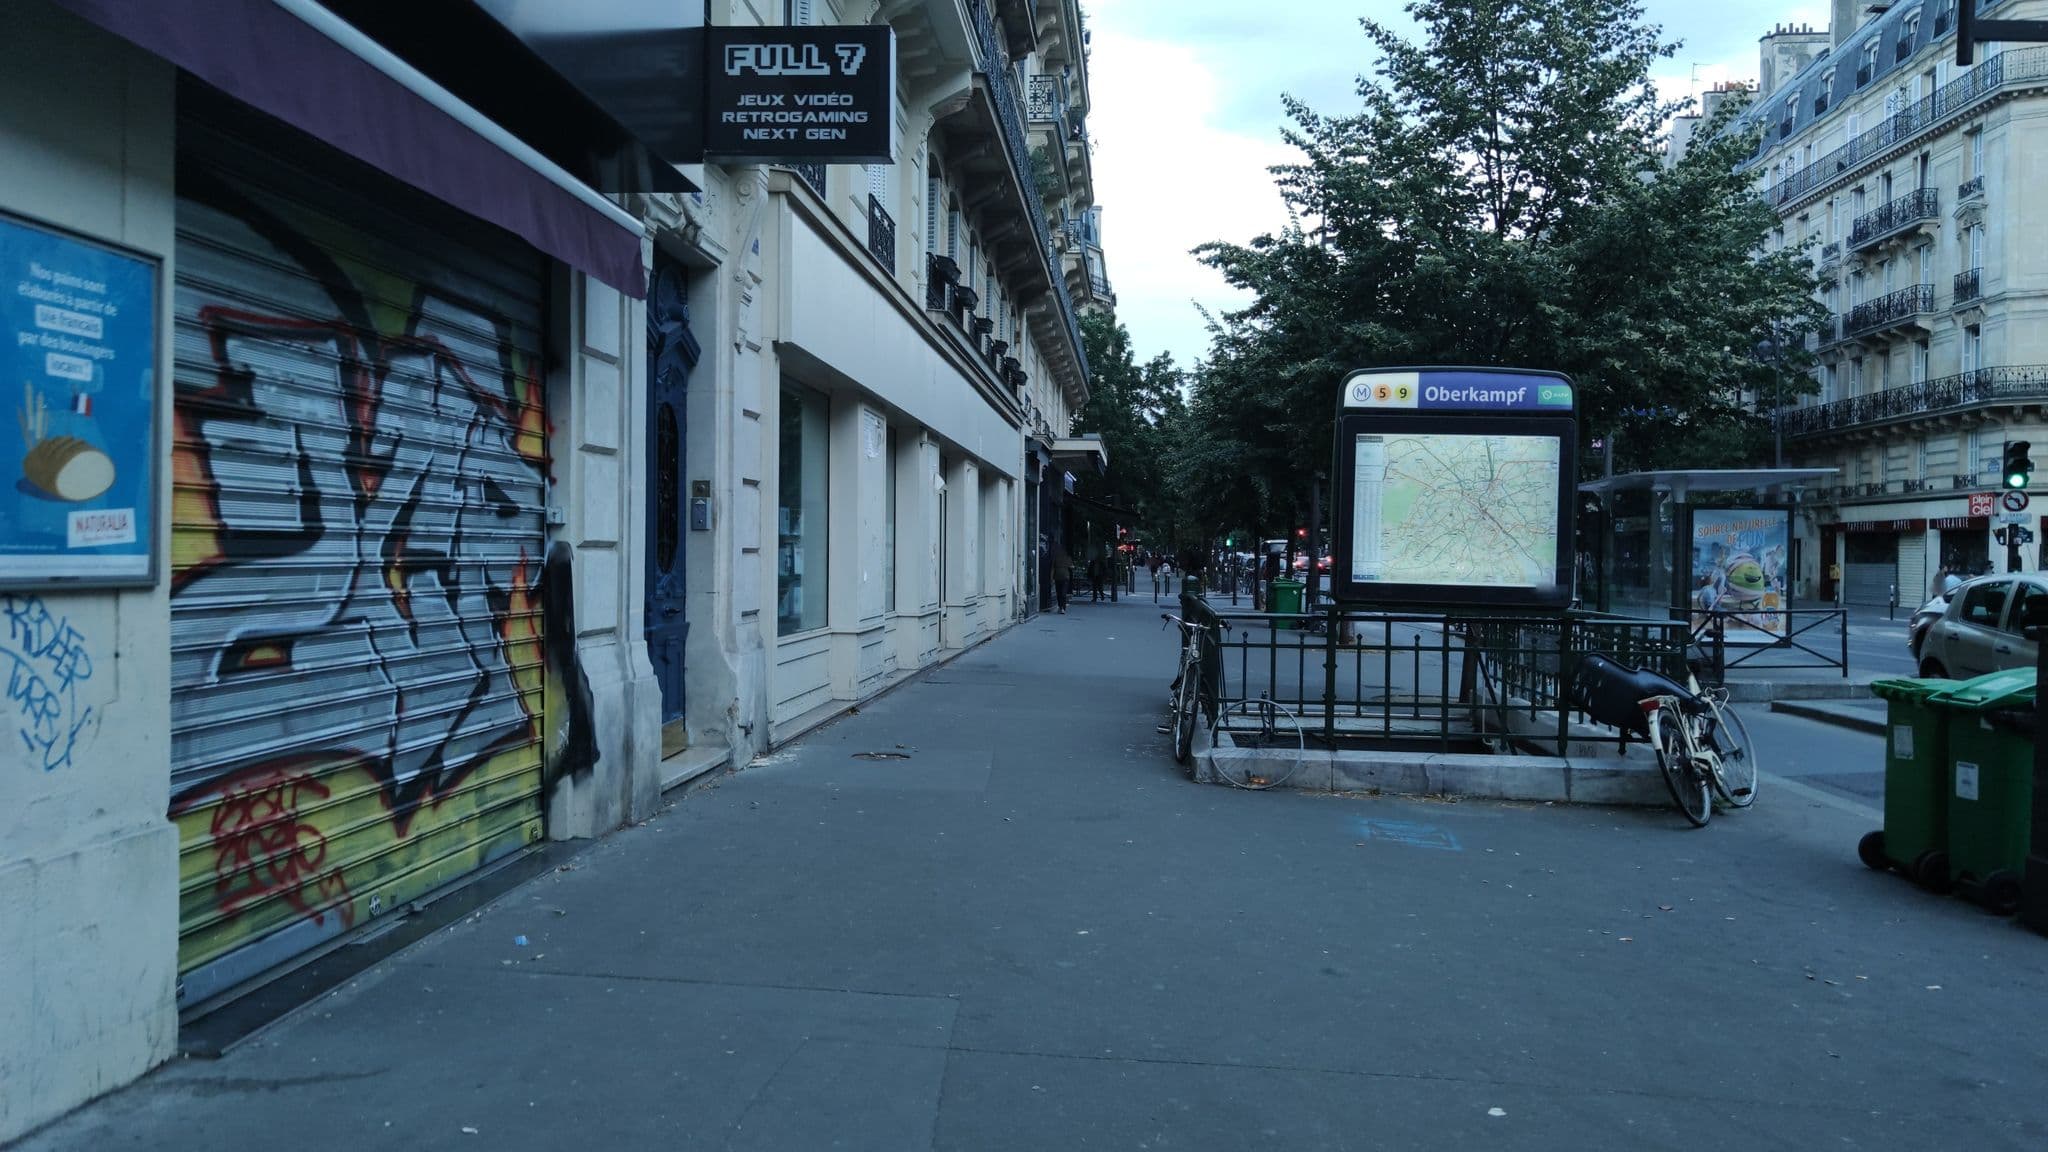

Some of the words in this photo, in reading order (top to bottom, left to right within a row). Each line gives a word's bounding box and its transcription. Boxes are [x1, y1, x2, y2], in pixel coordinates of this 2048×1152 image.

[725, 44, 830, 76] FULL
[835, 44, 866, 76] 7
[737, 95, 785, 106] JEUX
[794, 92, 853, 106] VIDÉO
[722, 112, 868, 123] RETROGAMING
[743, 129, 798, 140] NEXT
[805, 129, 846, 140] GEN
[1379, 388, 1387, 398] 5
[1399, 387, 1407, 399] 9
[1425, 386, 1527, 406] Oberkampf
[1972, 493, 1993, 505] plein
[1972, 504, 1993, 515] ciel
[75, 513, 128, 533] NATURALIA
[1698, 523, 1729, 538] SOURCE
[1731, 517, 1778, 533] NATURELLE
[1728, 534, 1737, 545] DE
